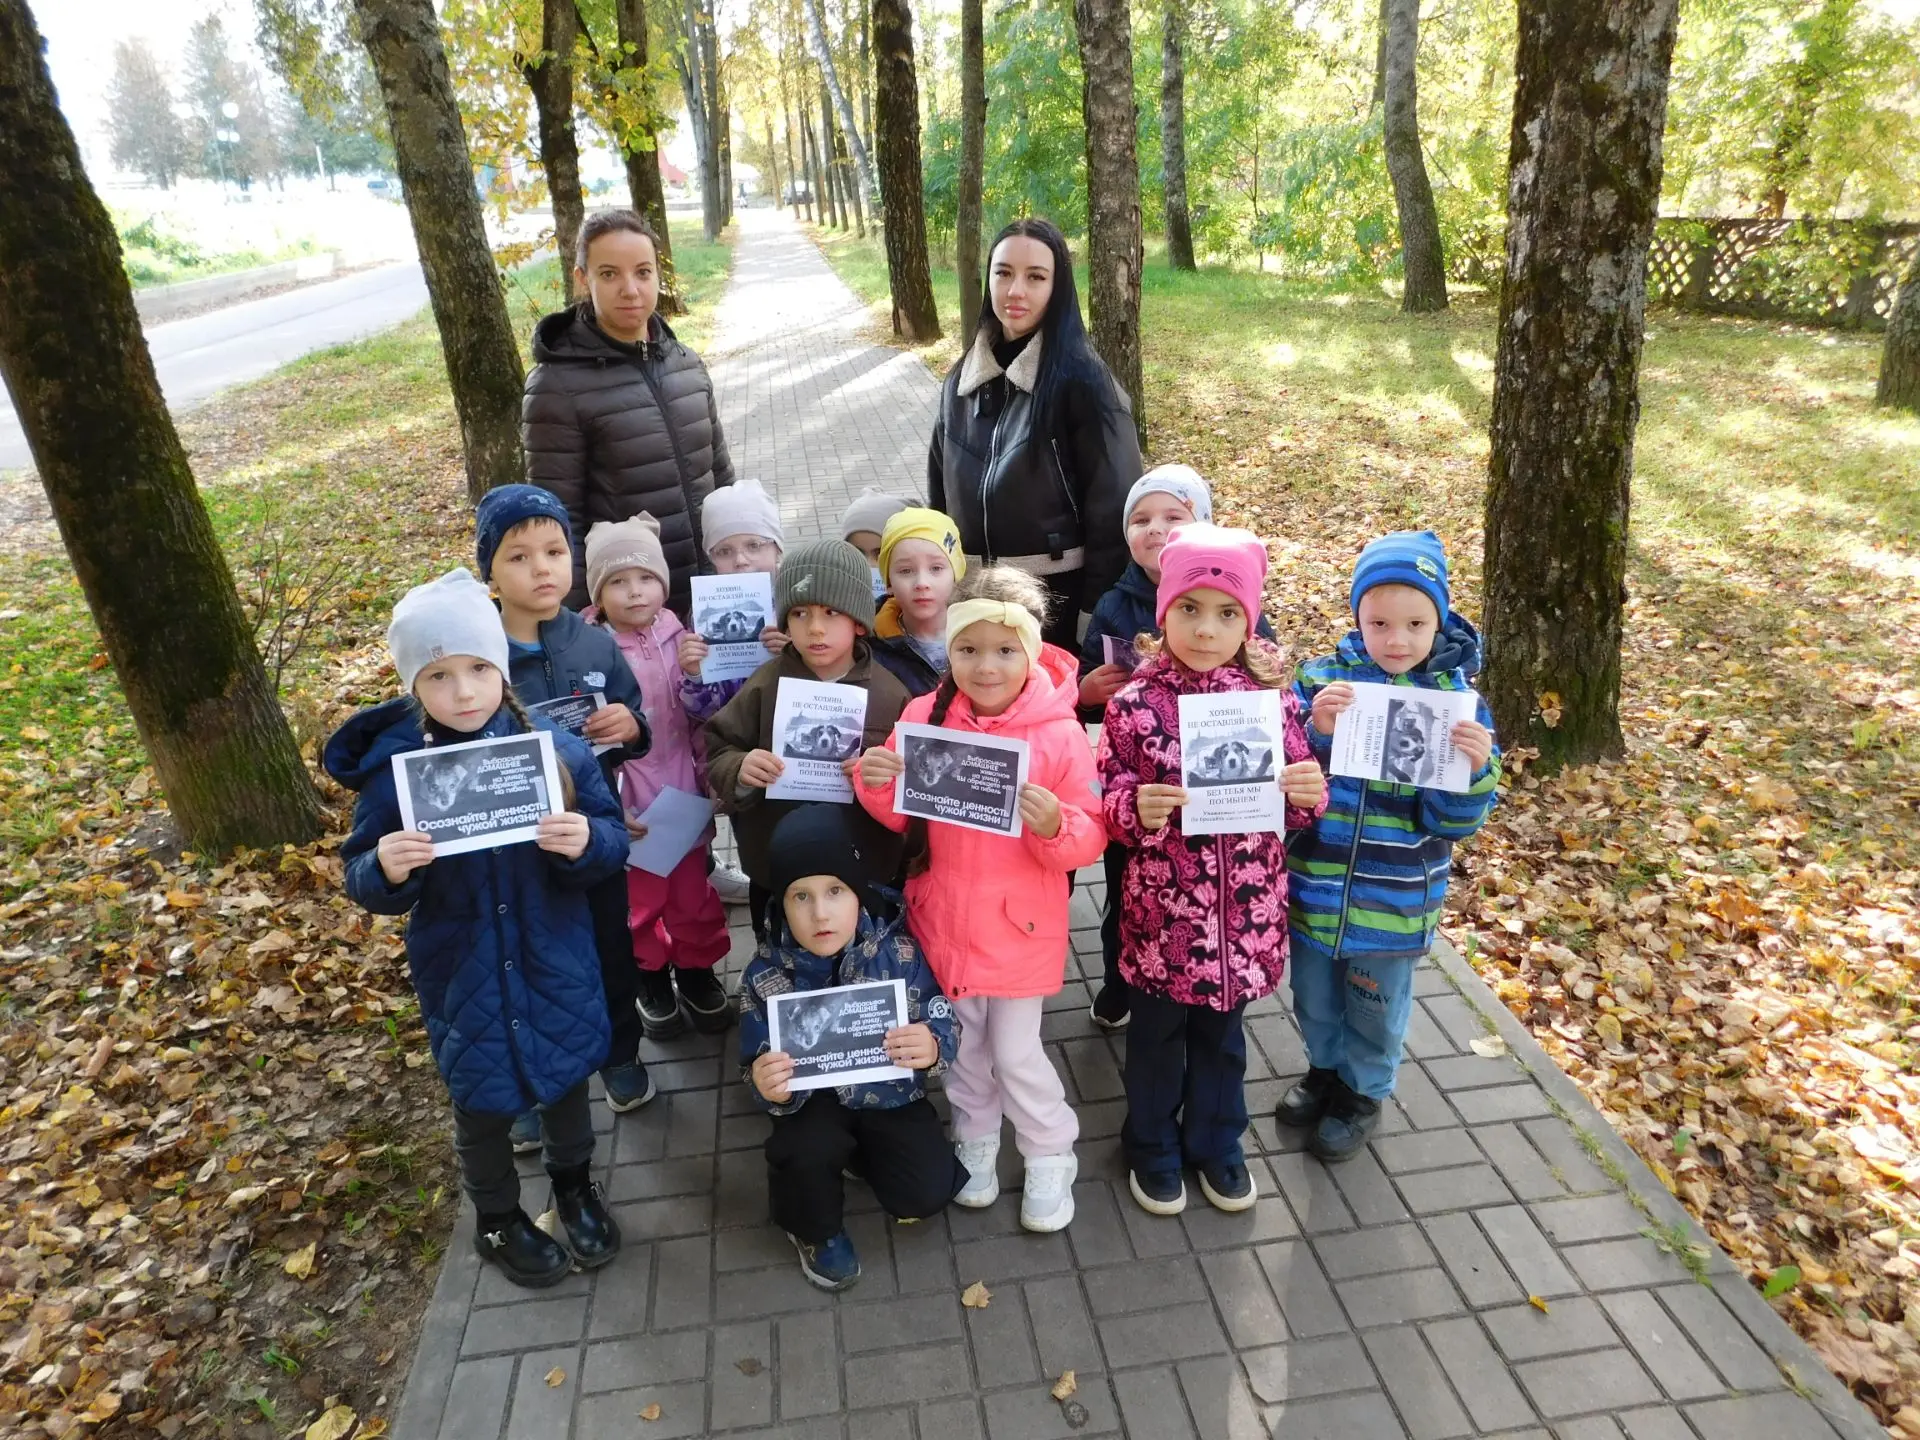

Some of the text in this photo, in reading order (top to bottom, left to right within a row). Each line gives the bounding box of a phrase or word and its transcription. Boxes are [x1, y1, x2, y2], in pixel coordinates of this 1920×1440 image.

[803, 703, 843, 713] ОСТАВЛЯЙ
[1209, 708, 1244, 717] ХОЗЯИН,
[1187, 716, 1267, 729] НЕ ОСТАВЛЯЙ НАС!
[477, 760, 521, 774] ДОМАШНЕЕ
[961, 760, 999, 771] ДОМАШНЕЕ
[980, 769, 1010, 779] животное
[504, 786, 531, 794] гибель
[980, 785, 1002, 795] гибель
[1224, 787, 1245, 795] ТЕБЯ
[905, 788, 1010, 818] Осознайте ценность
[417, 802, 548, 832] Осознайте ценность
[934, 804, 1000, 825] чужой жизни
[458, 813, 540, 835] чужой жизни
[839, 1005, 878, 1017] ДОМАШНЕЕ
[859, 1010, 891, 1019] животное
[936, 1004, 945, 1015] B
[793, 1047, 888, 1067] сознайте ценнос
[818, 1055, 890, 1073] чужой жизни
